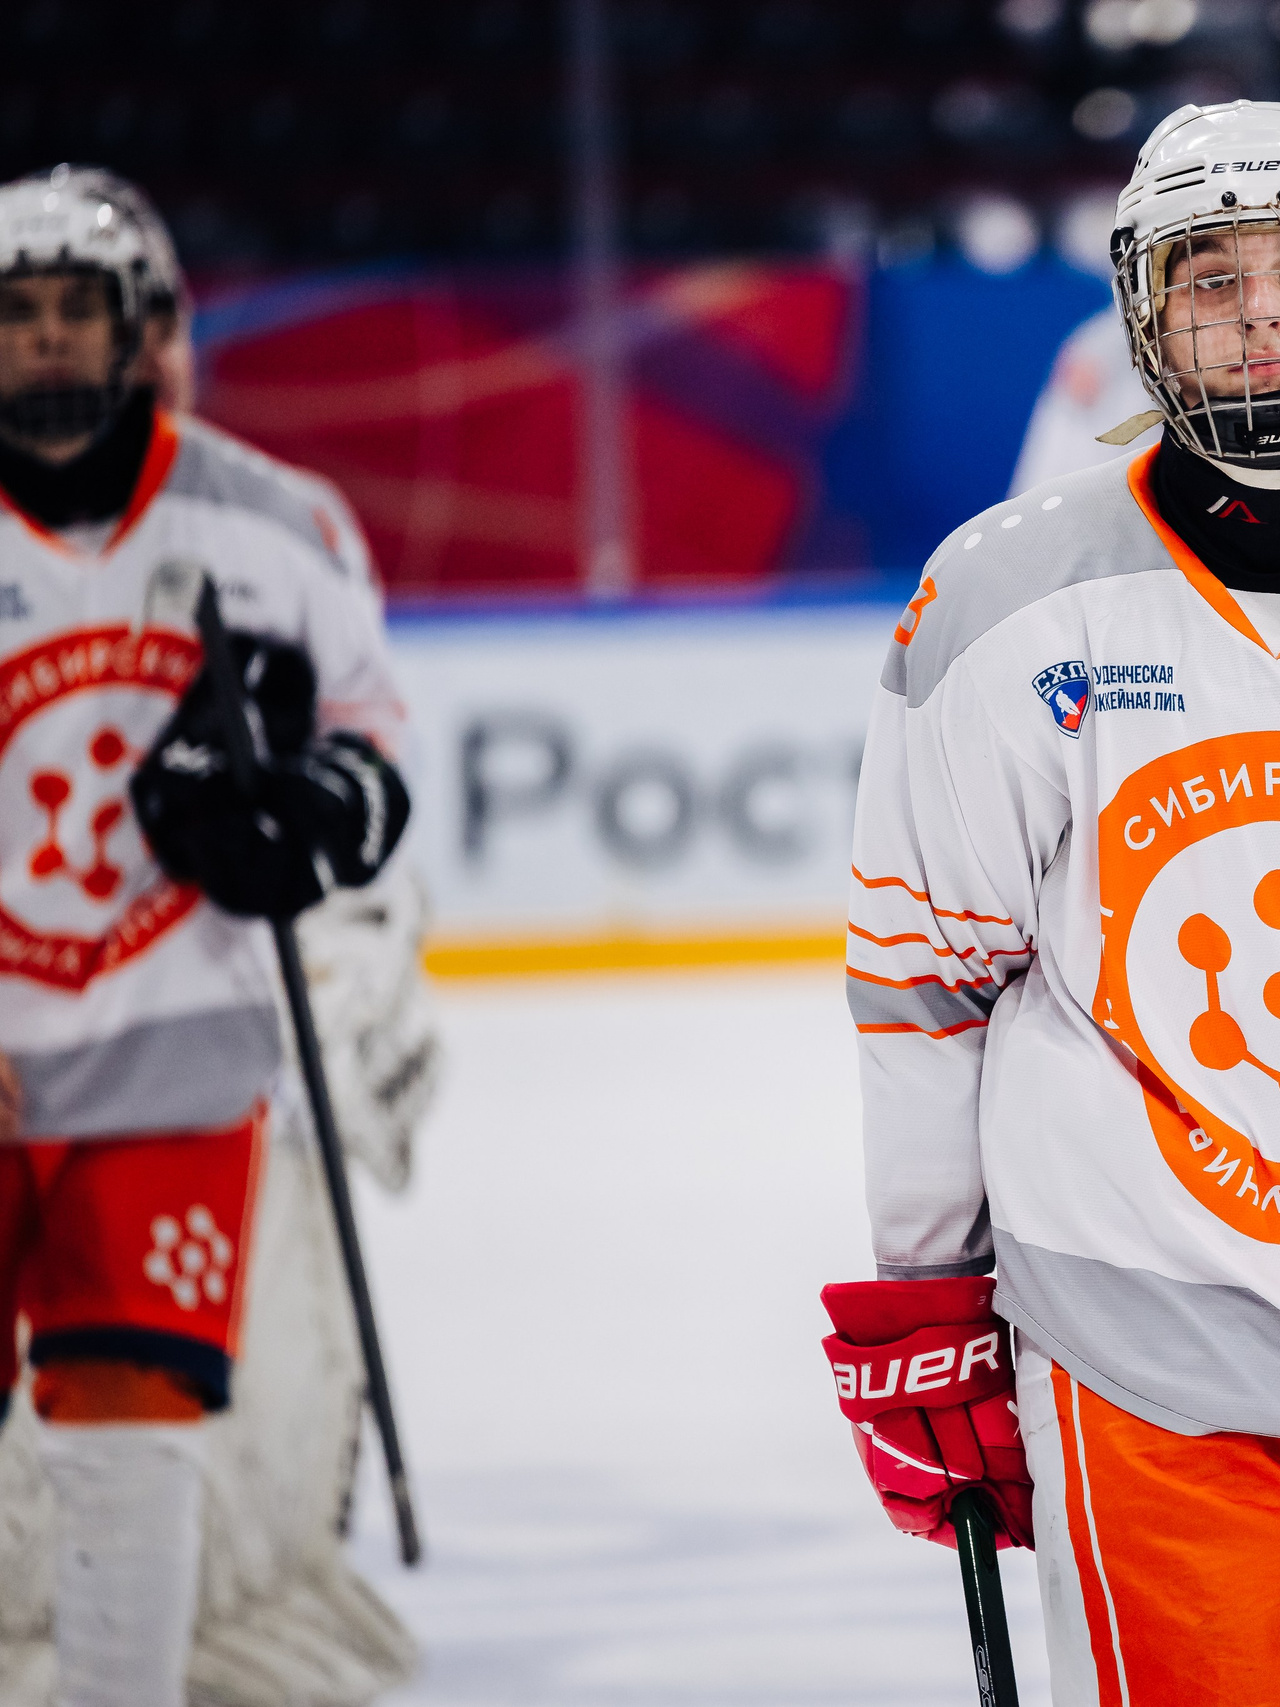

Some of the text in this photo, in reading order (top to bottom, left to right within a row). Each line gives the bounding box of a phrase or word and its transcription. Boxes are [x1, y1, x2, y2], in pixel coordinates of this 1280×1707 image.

[1091, 665, 1173, 686] УДЕНЧЕСКАЯ
[1153, 692, 1186, 712] ЛИГА
[460, 710, 862, 872] Рос
[833, 1331, 999, 1400] AUER
